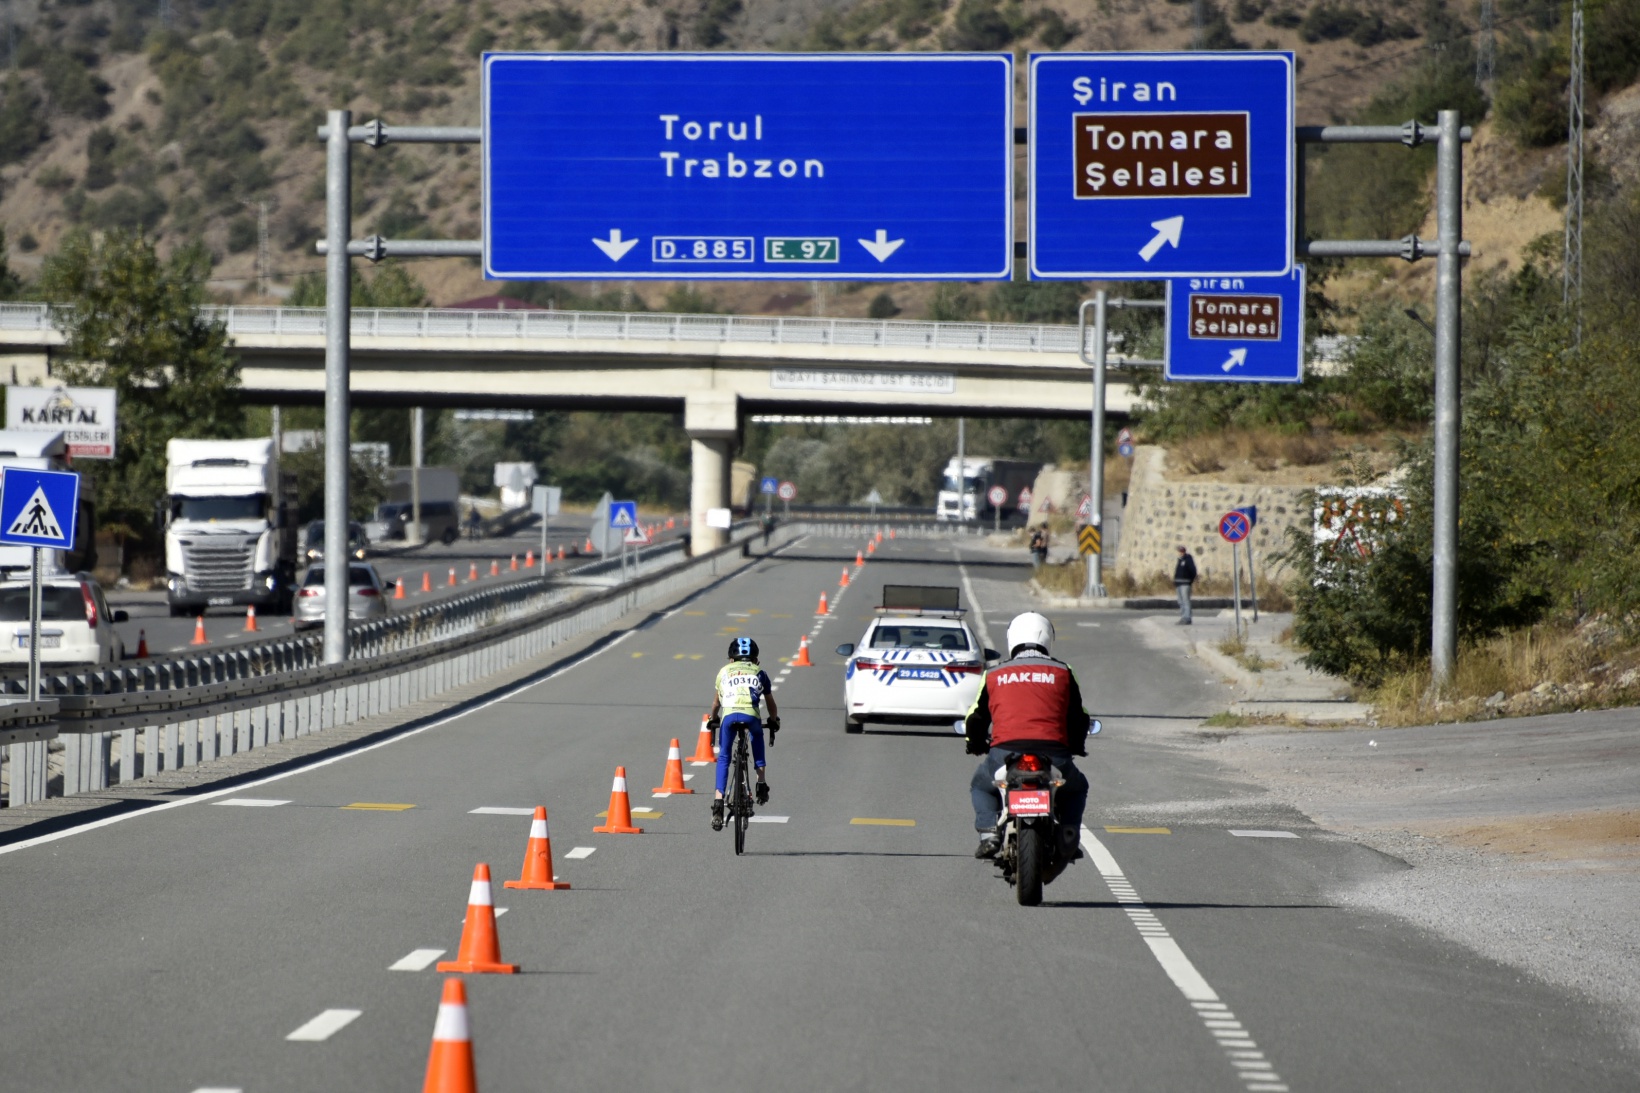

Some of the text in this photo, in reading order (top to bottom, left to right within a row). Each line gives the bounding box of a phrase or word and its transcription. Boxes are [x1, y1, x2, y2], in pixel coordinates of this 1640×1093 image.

[1072, 76, 1176, 105] Şiran
[659, 114, 762, 141] Torul
[1085, 125, 1233, 150] Tomara
[659, 151, 824, 178] Trabzon
[1085, 161, 1238, 191] Şelalesi
[660, 241, 746, 258] D.885
[771, 241, 832, 258] E.97
[1195, 299, 1274, 316] Tomara
[1194, 318, 1276, 335] Şelalesi
[22, 406, 101, 424] KARTAL
[900, 670, 941, 680] 29 A 5428
[997, 672, 1055, 686] HAKEM
